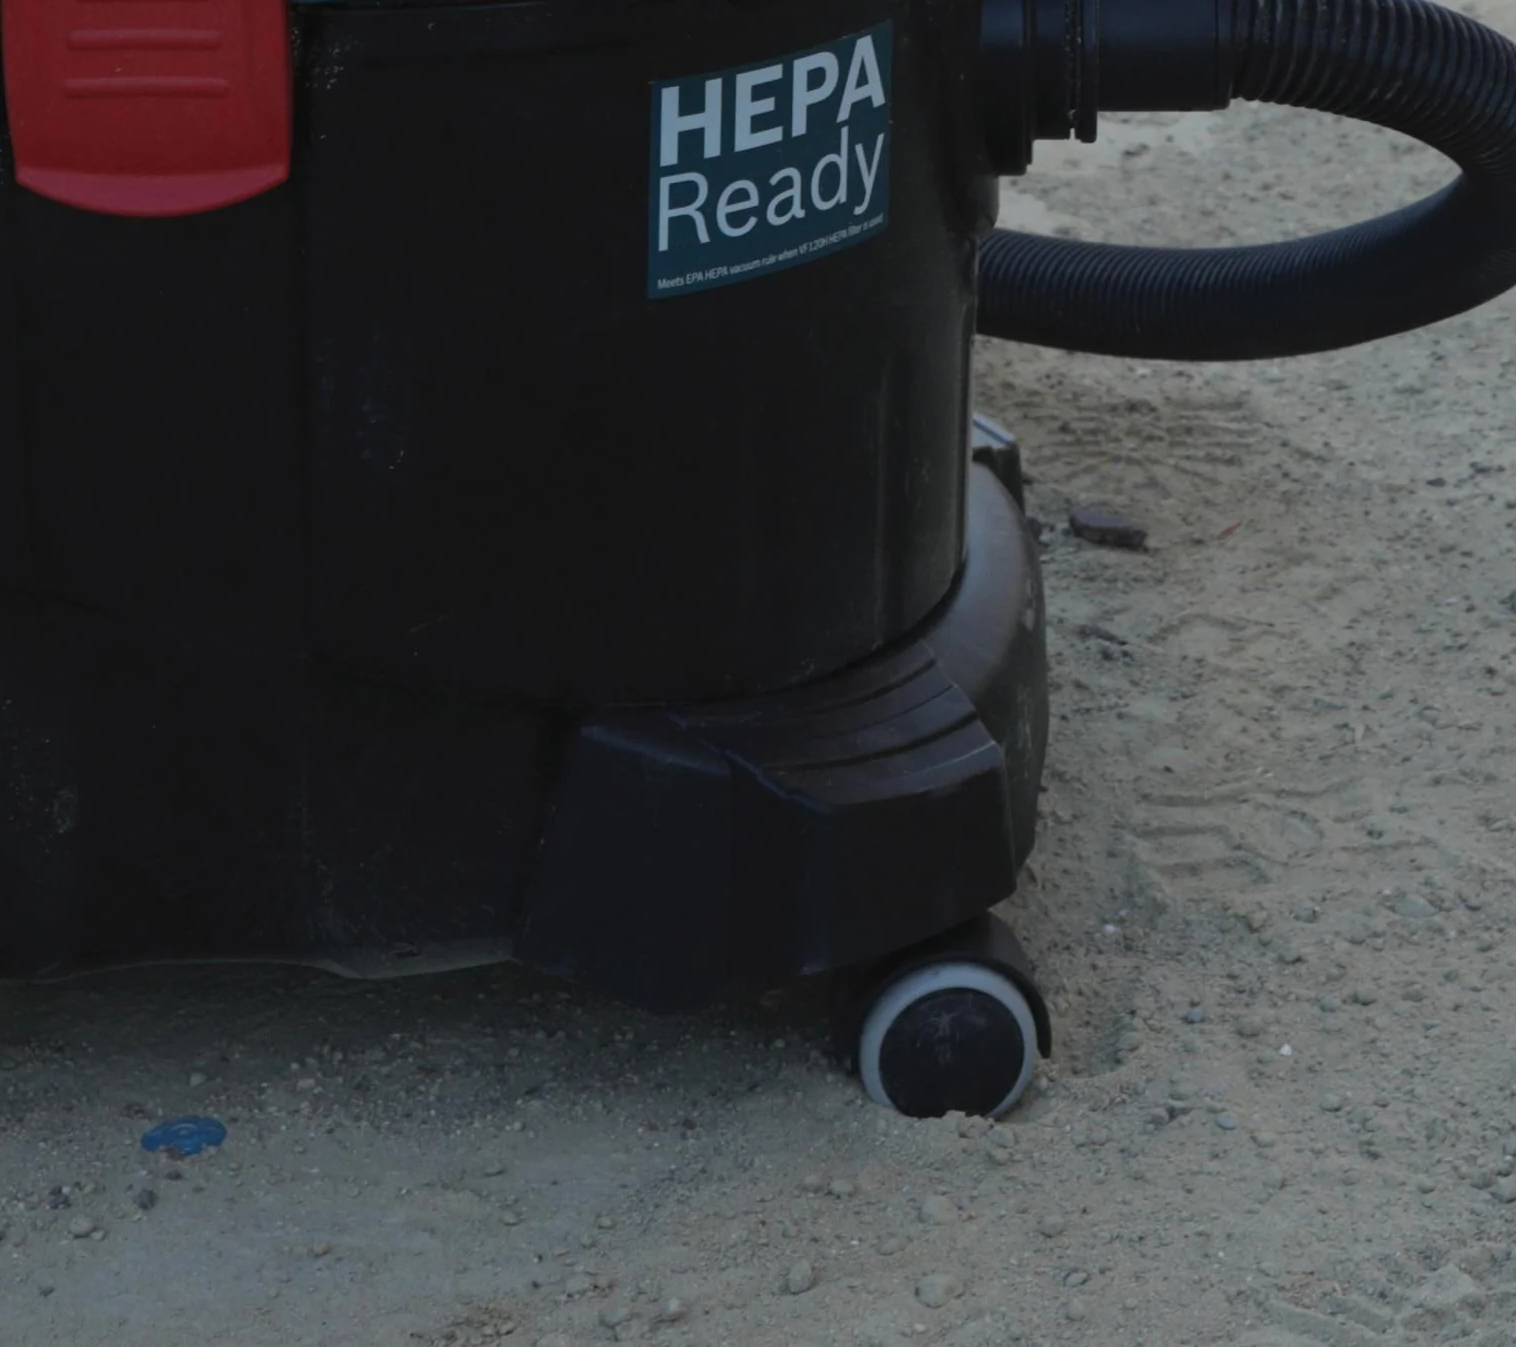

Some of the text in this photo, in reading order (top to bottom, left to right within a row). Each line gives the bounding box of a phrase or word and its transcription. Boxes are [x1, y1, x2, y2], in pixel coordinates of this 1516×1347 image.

[659, 34, 886, 167] HEPA
[658, 125, 885, 252] Ready
[657, 276, 685, 290] Meets
[686, 273, 704, 285] EPA
[705, 267, 729, 282] HEPA
[729, 259, 762, 275] vacuum
[778, 247, 799, 262] when
[828, 229, 848, 245] HEPA
